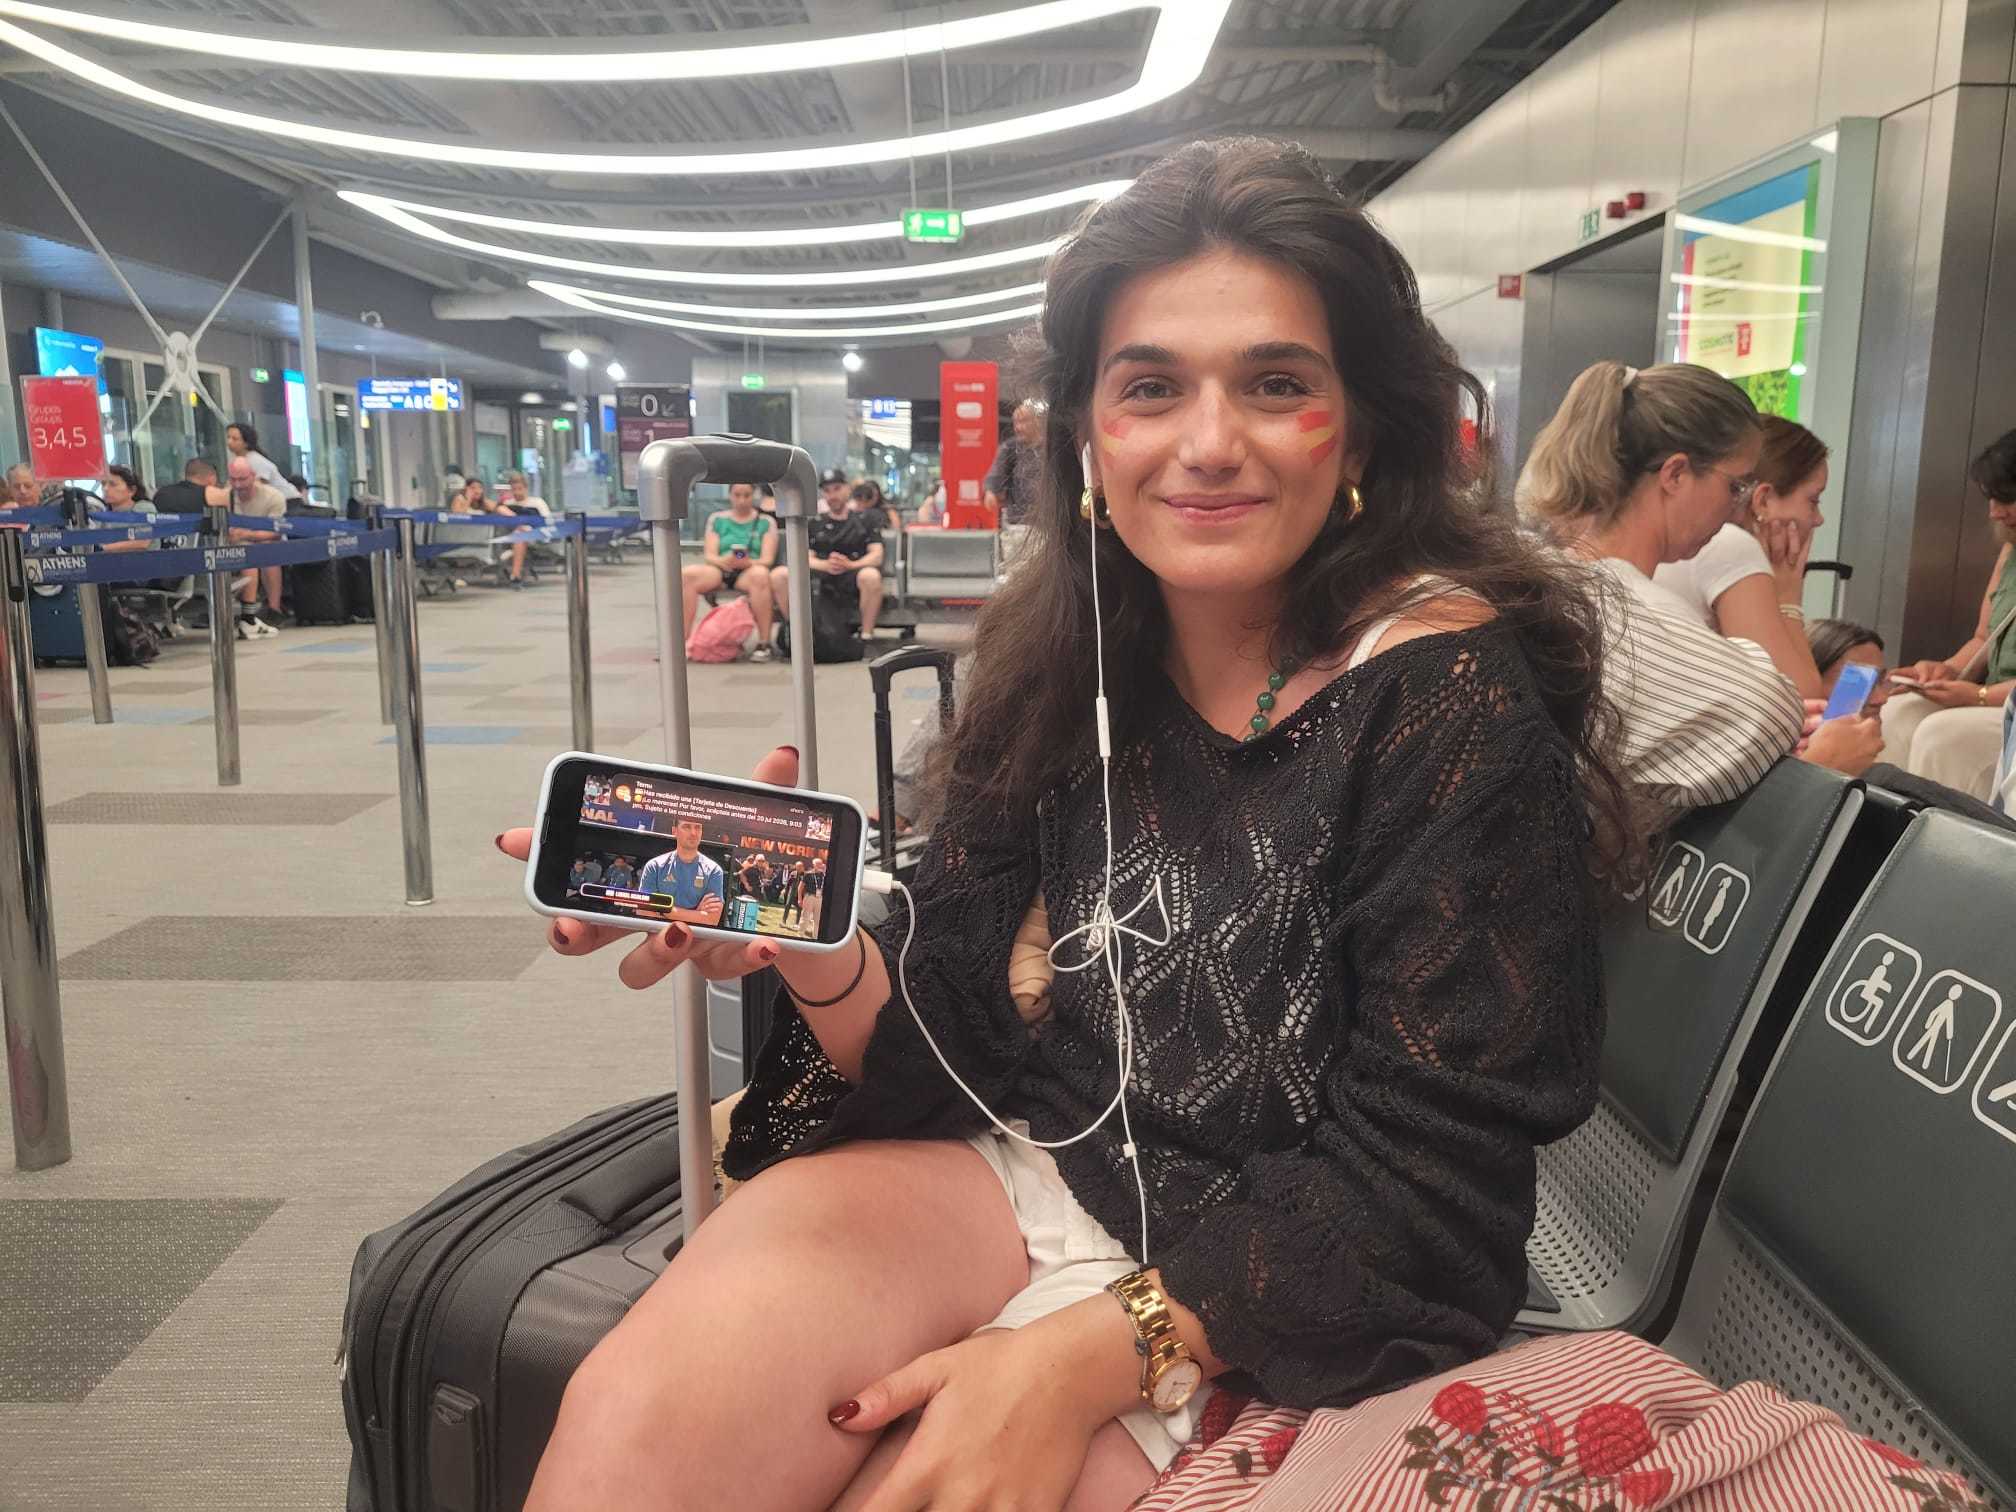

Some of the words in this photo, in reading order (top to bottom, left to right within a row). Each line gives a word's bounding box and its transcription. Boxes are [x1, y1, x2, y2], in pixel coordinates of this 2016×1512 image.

[34, 426, 87, 450] 3,4,5
[215, 548, 246, 559] ATHENS
[42, 556, 87, 570] ATHENS
[741, 835, 775, 852] NEW
